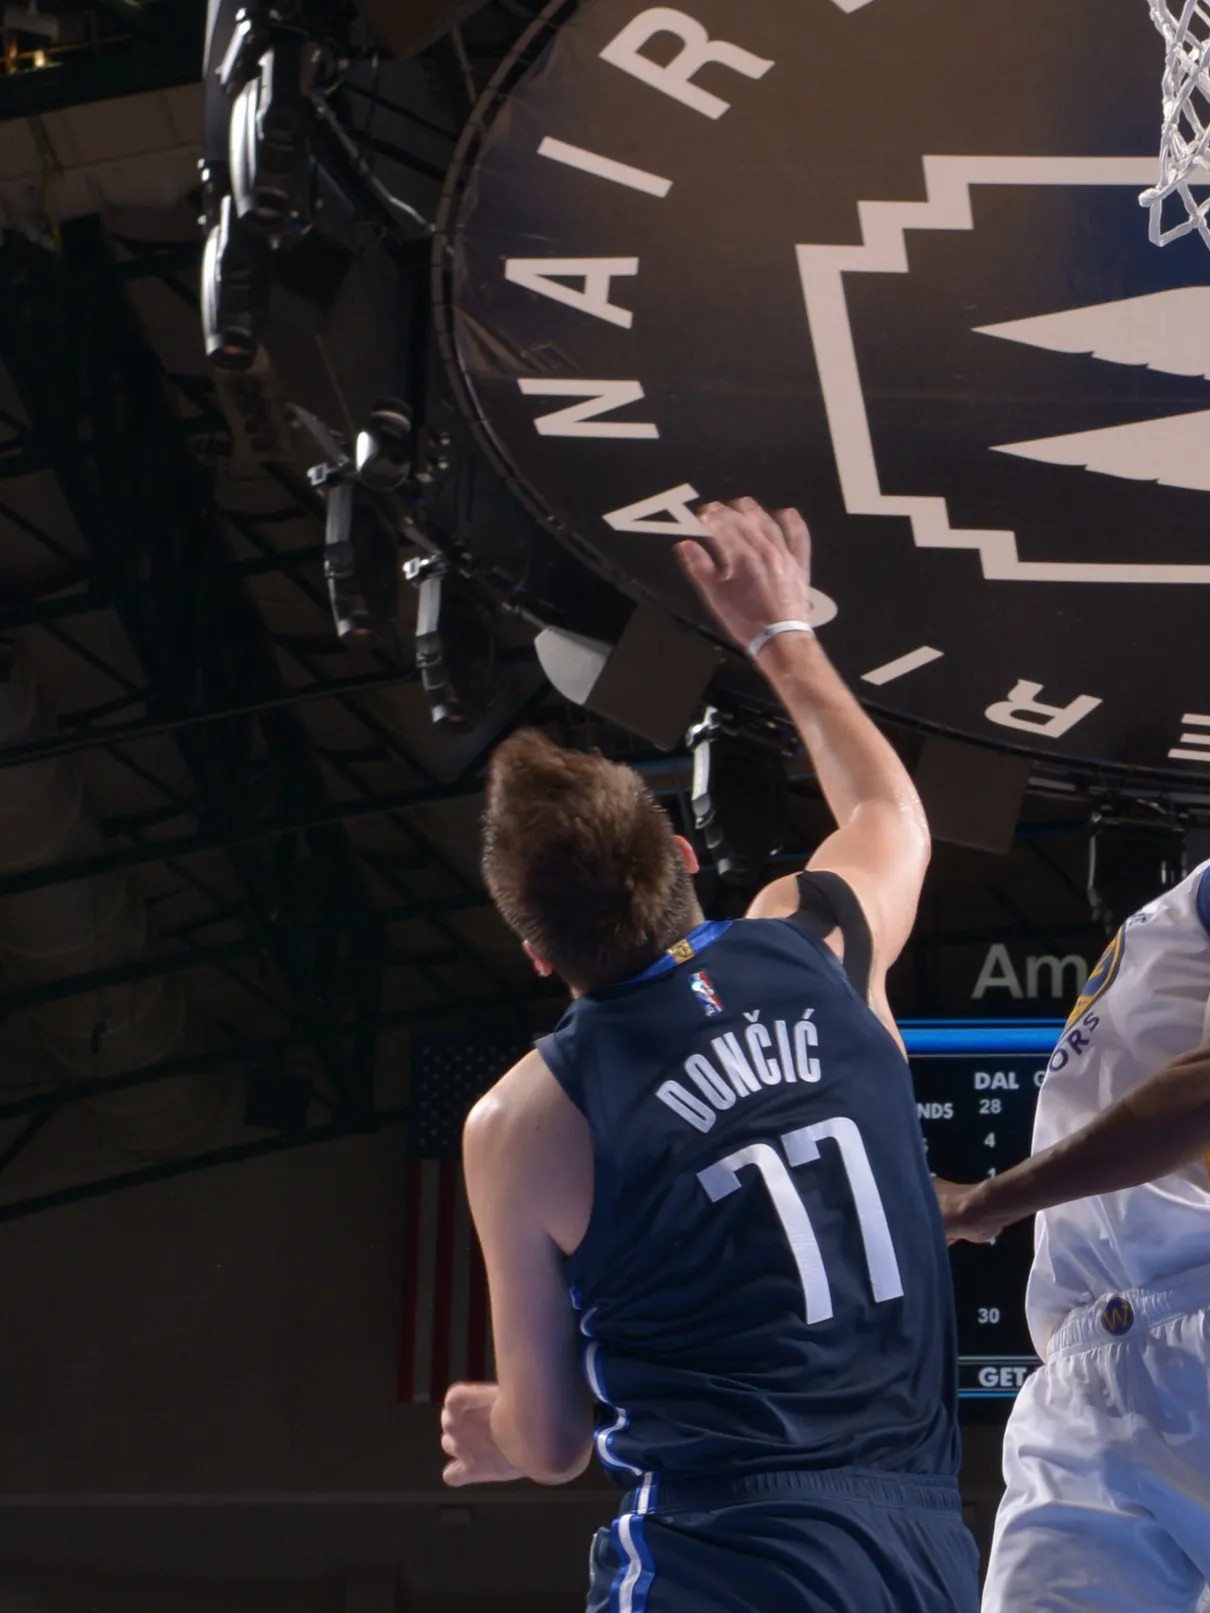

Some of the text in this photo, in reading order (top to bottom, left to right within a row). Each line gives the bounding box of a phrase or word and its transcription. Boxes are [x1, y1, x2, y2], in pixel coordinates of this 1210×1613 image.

[655, 1008, 821, 1133] DONČIĆ
[974, 1071, 1020, 1090] DAL
[978, 1098, 1002, 1115] 28
[983, 1131, 996, 1148] 4
[696, 1117, 904, 1325] 77
[977, 1307, 1000, 1325] 30
[978, 1366, 1028, 1388] GET
